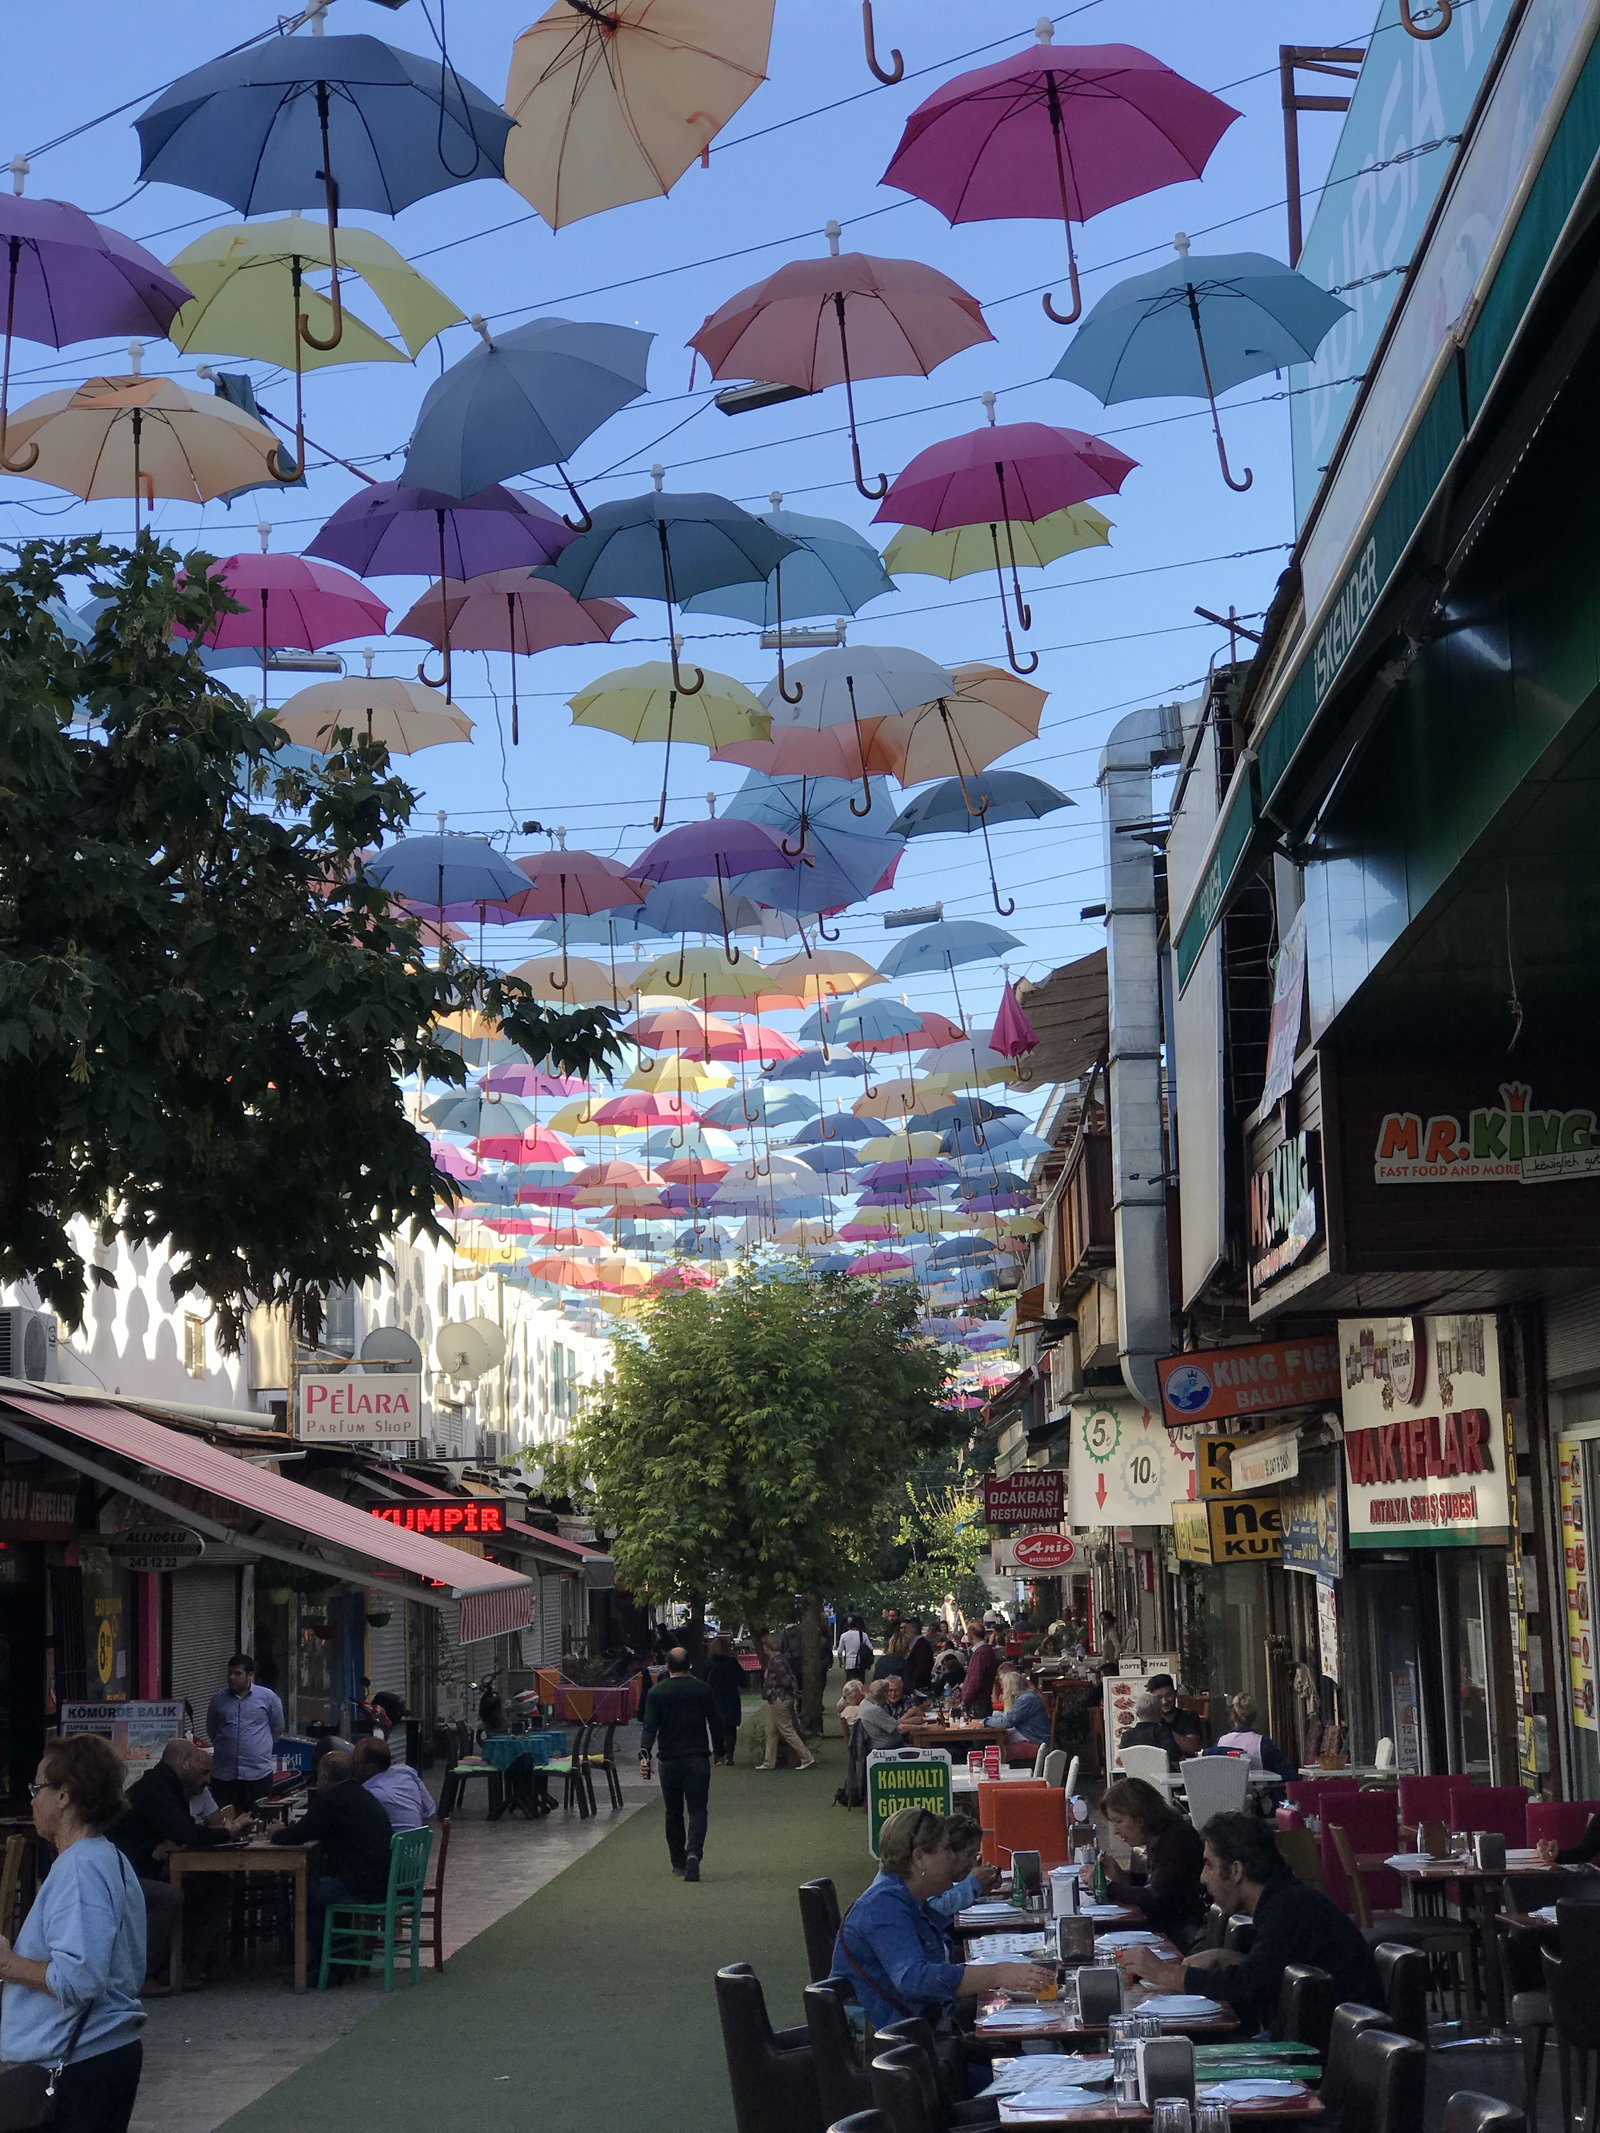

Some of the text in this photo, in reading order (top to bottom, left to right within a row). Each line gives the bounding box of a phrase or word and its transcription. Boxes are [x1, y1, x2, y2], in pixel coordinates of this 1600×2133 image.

[1380, 1163, 1520, 1177] FAST FOOD AND MORE
[1213, 1354, 1278, 1388] KING
[1236, 1384, 1297, 1408] BALIK
[307, 1420, 365, 1433] PARFUM
[1345, 1409, 1494, 1485] VAKIFLAR
[989, 1490, 1059, 1506] OCAKBAŞI
[990, 1507, 1060, 1521] RESTAURANT
[1370, 1487, 1478, 1526] ANTALYA SATIŞ ŞUBESİ
[1018, 1540, 1071, 1556] Anis
[151, 1557, 162, 1567] 12
[67, 1705, 177, 1719] KÖMÜRDE BALIK
[878, 1768, 944, 1790] KAHVALTI
